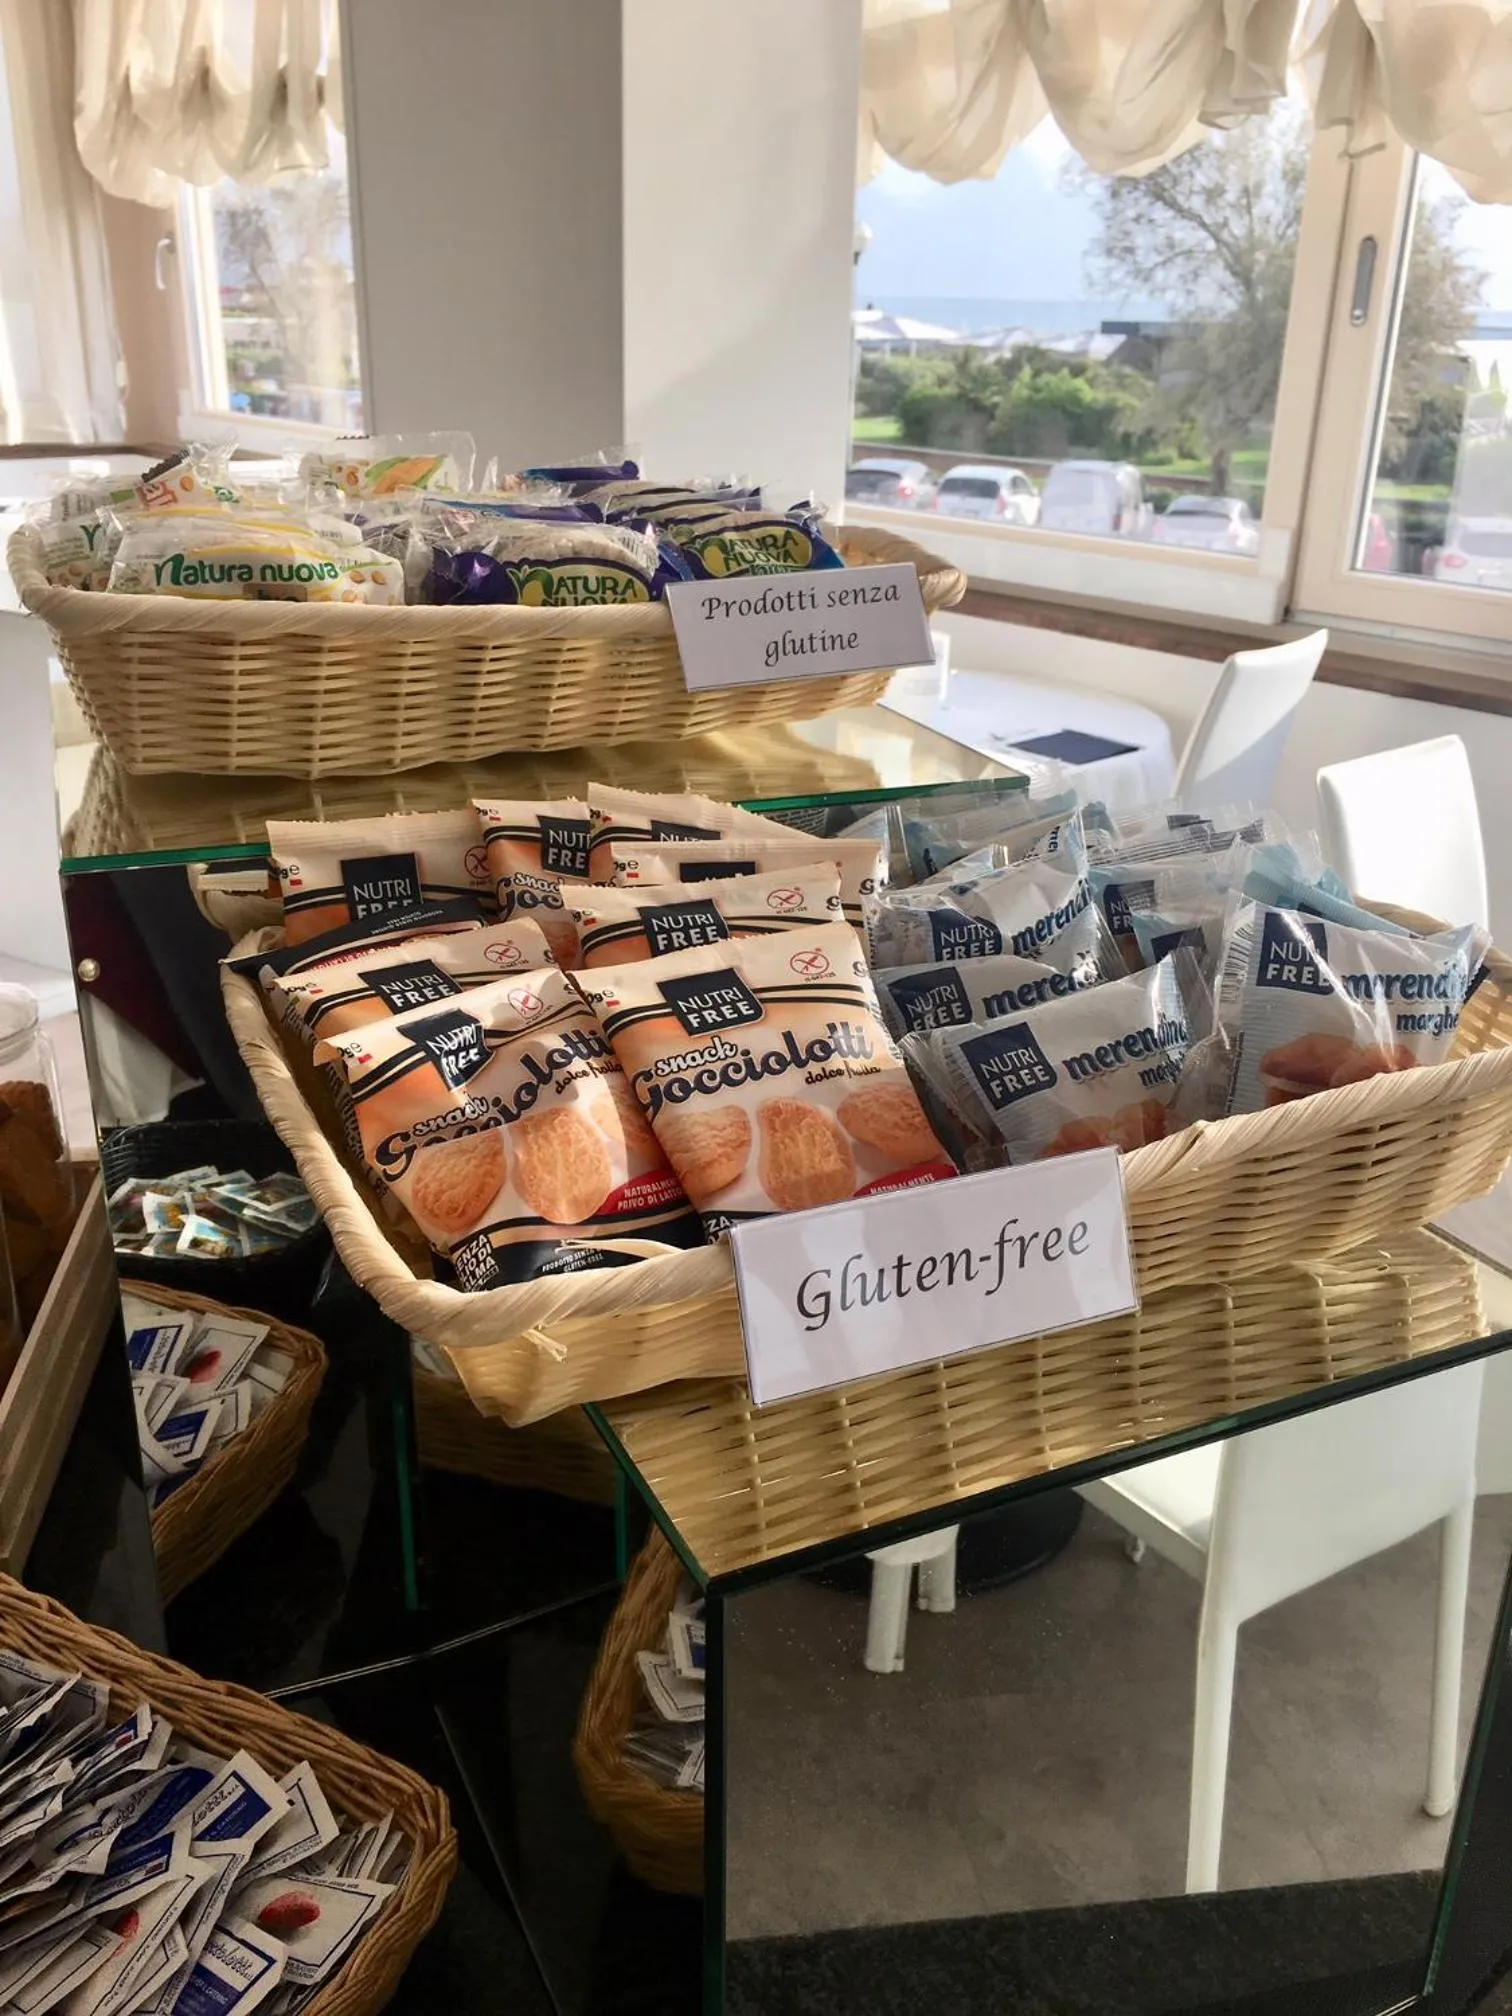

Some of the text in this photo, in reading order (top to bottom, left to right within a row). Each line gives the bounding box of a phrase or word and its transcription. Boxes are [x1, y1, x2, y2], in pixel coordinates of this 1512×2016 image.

[260, 560, 340, 583] nuova
[701, 584, 901, 620] Prodotti senza
[764, 629, 861, 668] glutine
[352, 878, 412, 902] NUTRI
[651, 913, 715, 932] NUTRI
[940, 923, 995, 946] NUTRI
[656, 926, 722, 951] FREE
[941, 939, 996, 960] FREE
[380, 974, 444, 994] NUTRI
[390, 984, 456, 1007] FREE
[677, 986, 743, 1014] NUTRI
[686, 1000, 755, 1028] FREE
[905, 983, 959, 1018] NUTRI
[912, 1002, 965, 1032] FREE
[426, 1023, 478, 1055] NUTRI
[654, 1035, 738, 1077] snack
[980, 1046, 1038, 1079] NUTRI
[555, 1070, 590, 1094] dolce
[632, 1021, 874, 1126] Gocciolotti
[804, 1066, 845, 1085] dolce
[989, 1065, 1050, 1100] FREE
[412, 1090, 490, 1138] snack
[617, 1196, 645, 1211] PRIVO
[647, 1194, 658, 1205] DI
[796, 1218, 1091, 1331] Gluten-free
